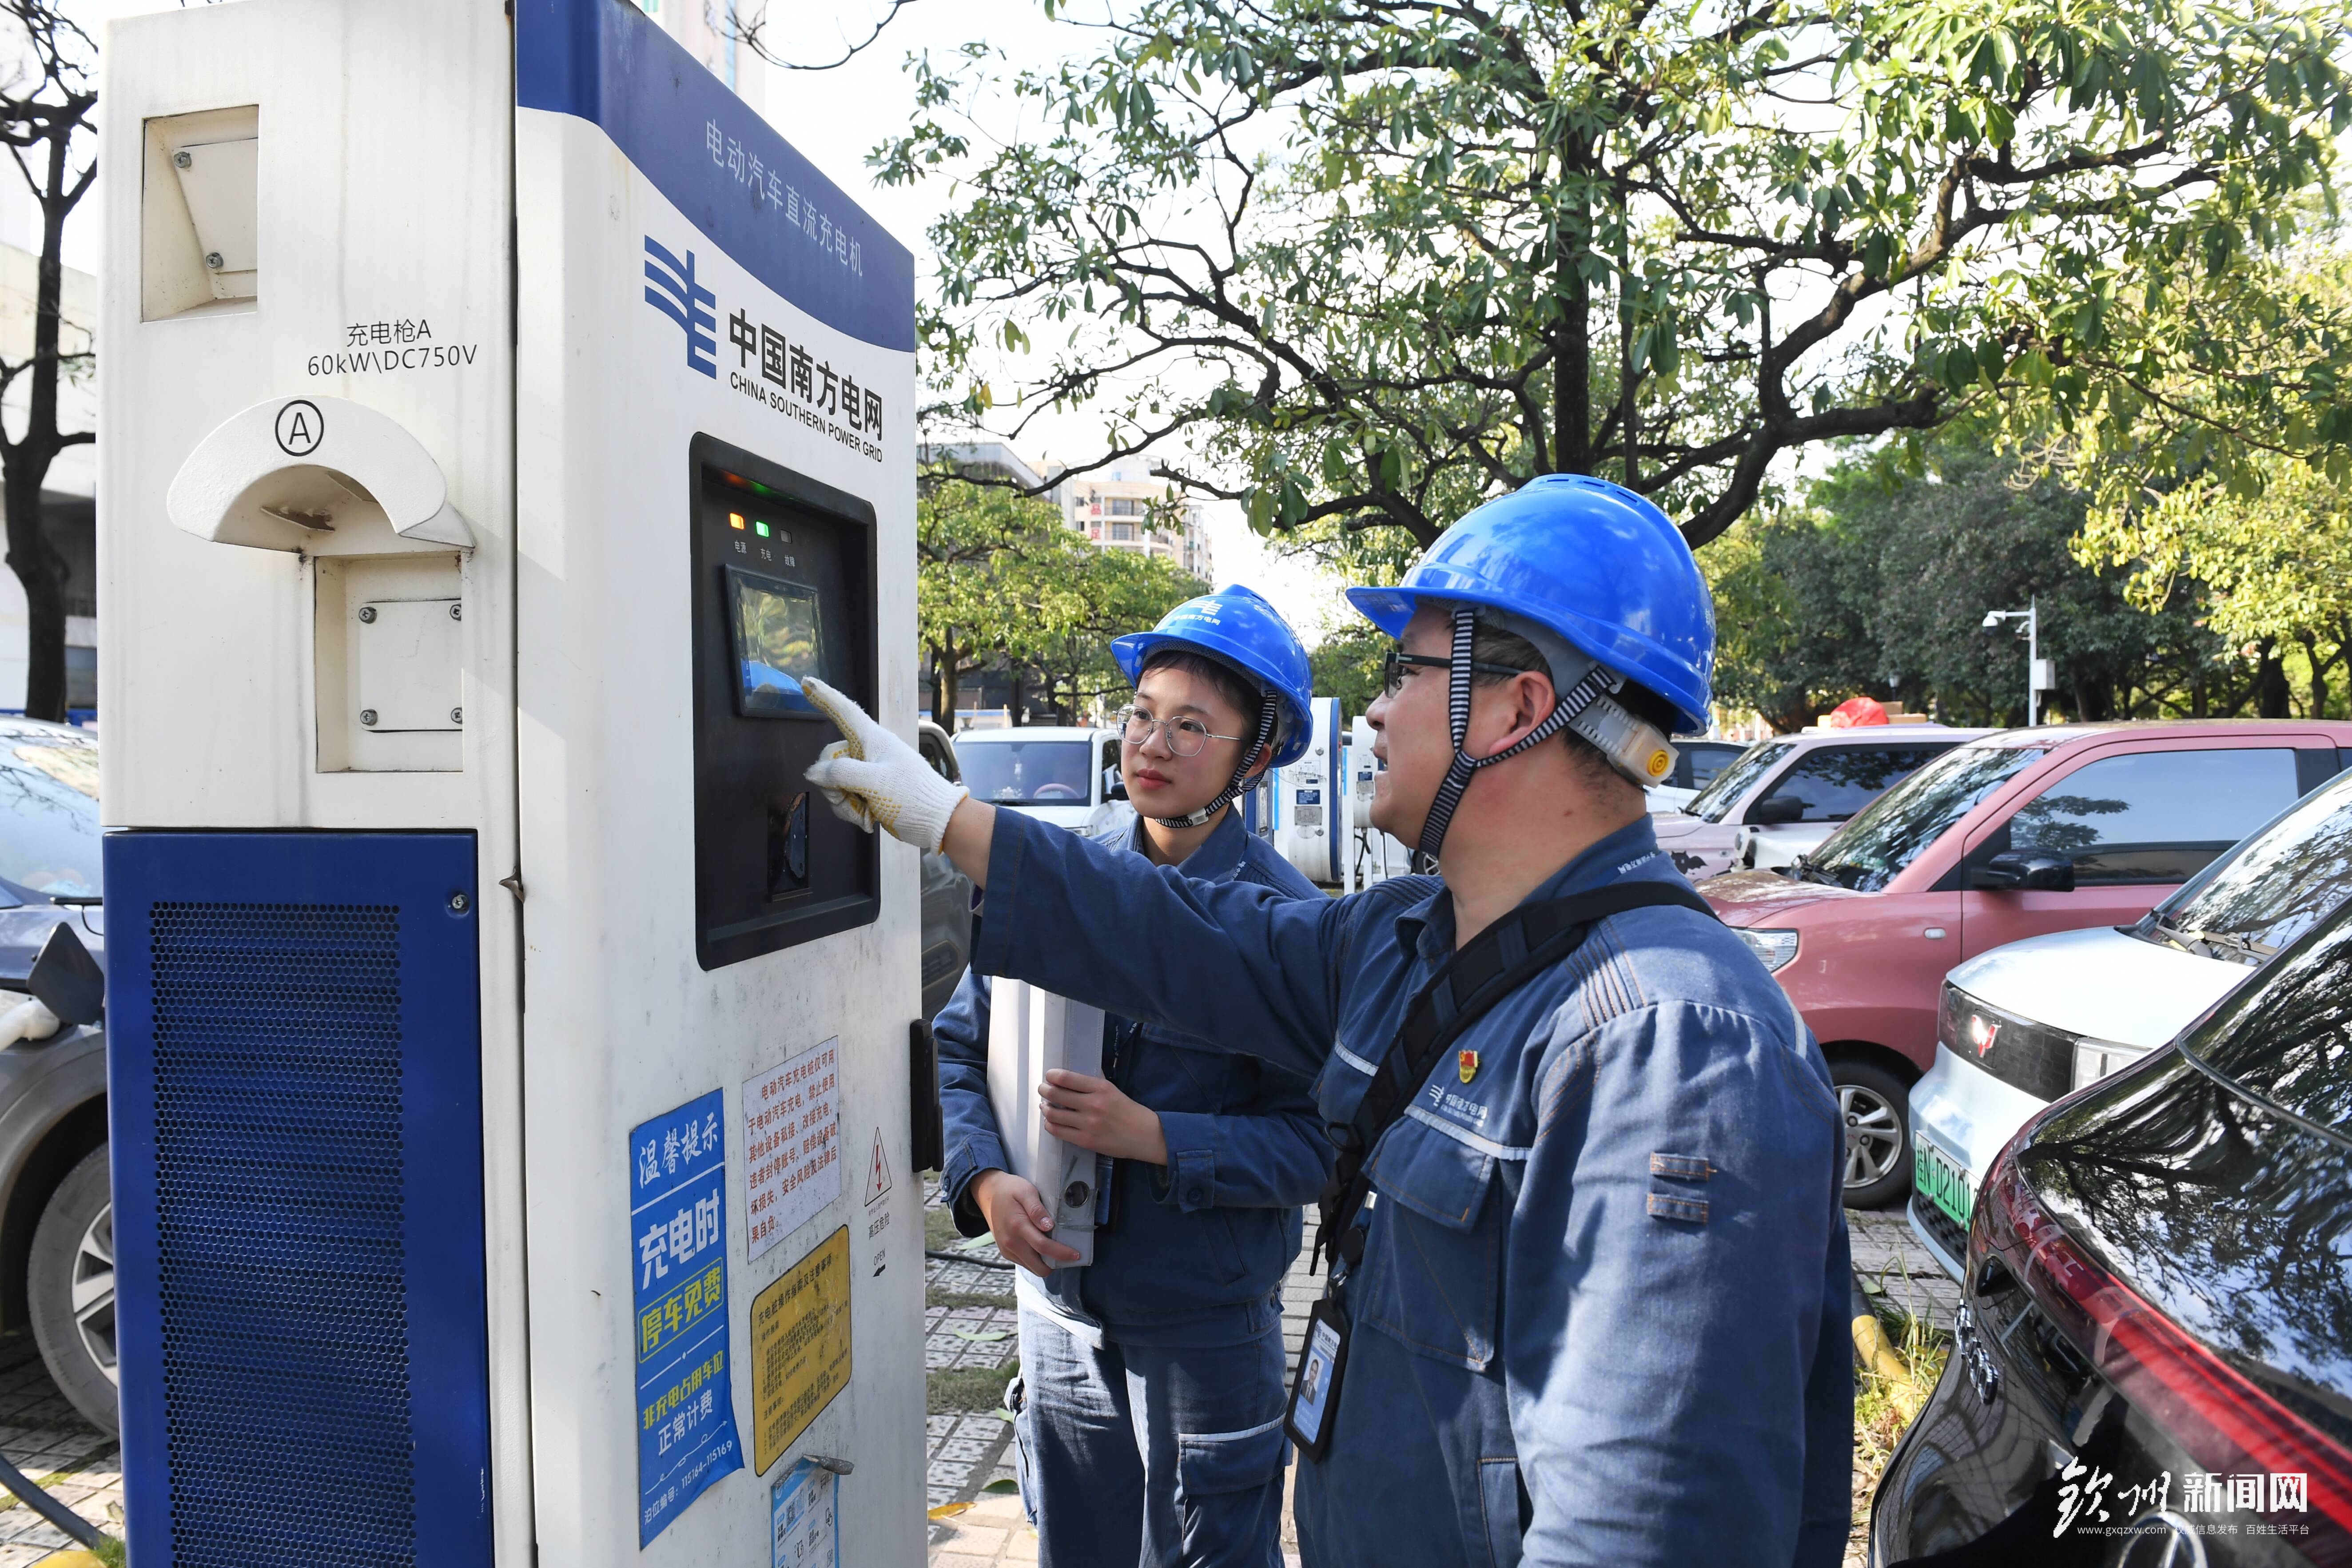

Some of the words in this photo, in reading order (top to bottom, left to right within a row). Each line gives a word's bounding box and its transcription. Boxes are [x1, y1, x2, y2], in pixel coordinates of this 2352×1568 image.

[706, 119, 863, 277] 电动汽车直流充电机
[307, 344, 477, 376] 60kW\DC750V
[346, 318, 431, 347] 充电枪A
[729, 308, 882, 441] 中国南方电网
[730, 371, 767, 405] CHINA
[770, 392, 825, 436] SOUTHERN
[828, 424, 861, 454] POWER
[862, 441, 883, 463] GRID
[735, 540, 747, 554] 电源
[760, 548, 772, 561] 充电
[748, 1073, 835, 1135] 于电动汽车充电，禁止使用
[762, 1049, 834, 1100] 电动汽车充电桩仅可用
[639, 1112, 718, 1189] 温馨提示
[748, 1102, 832, 1163] 其他设备私接、改接充电，
[639, 1188, 720, 1291] 充电时
[868, 1212, 890, 1238] 高压危险
[874, 1249, 885, 1266] OPEN
[641, 1265, 721, 1354] 停车免费
[758, 1253, 832, 1327] 充电桩操作指南及注意事项
[643, 1350, 724, 1430] 非充电占用车位
[658, 1389, 713, 1456] 正常计费
